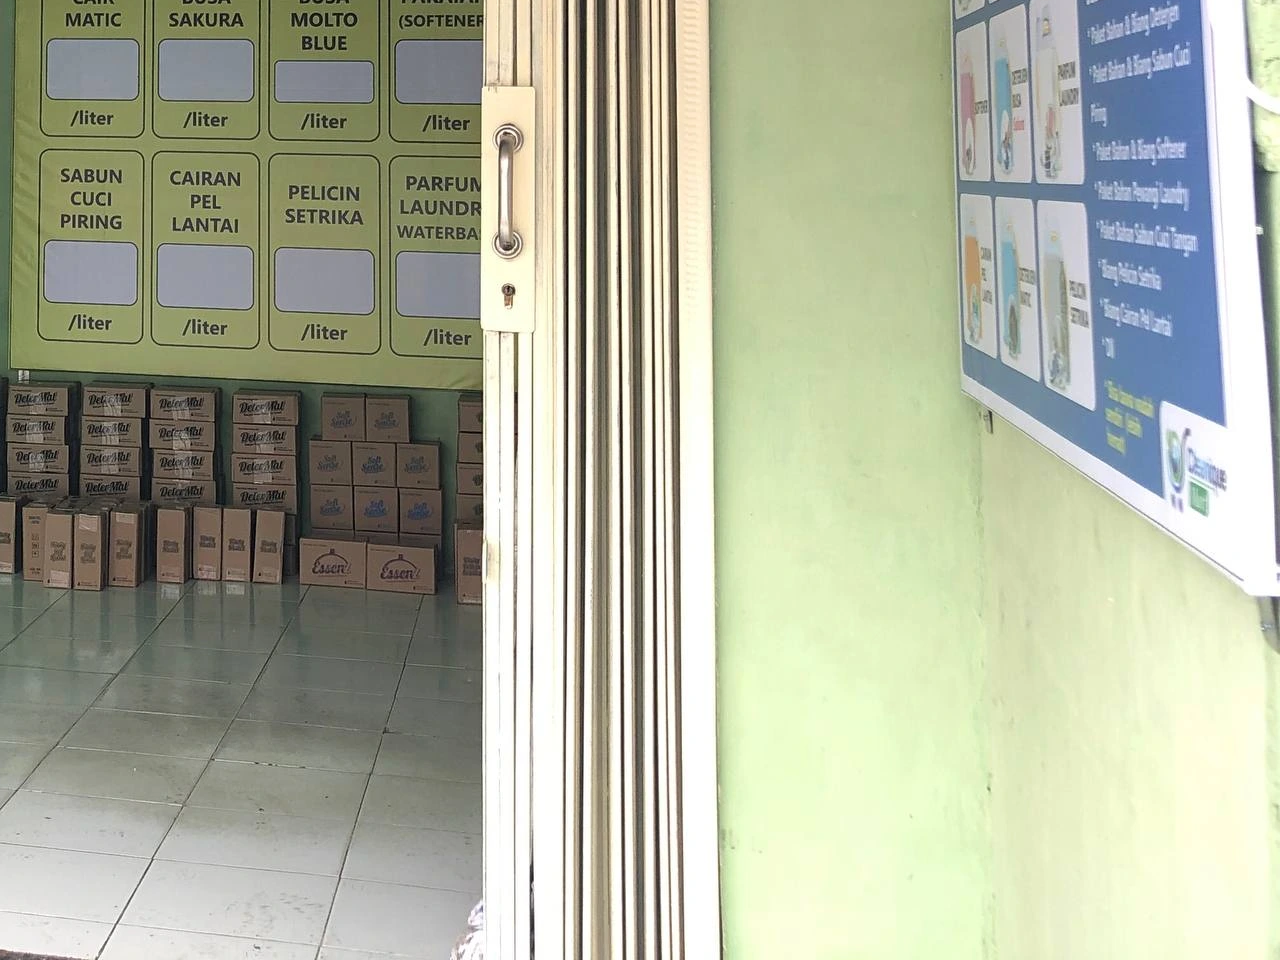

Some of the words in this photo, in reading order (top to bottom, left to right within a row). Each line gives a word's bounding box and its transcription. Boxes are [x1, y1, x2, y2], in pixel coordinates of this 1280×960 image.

[64, 12, 122, 29] MATIC
[168, 12, 244, 29] SAKURA
[290, 11, 359, 29] MOLTO
[301, 34, 347, 52] BLUE
[70, 111, 114, 128] /liter
[183, 111, 228, 129] /liter
[300, 113, 347, 131] /liter
[422, 115, 470, 133] /liter
[60, 168, 123, 185] SABUN
[169, 170, 241, 188] CAIRAN
[70, 191, 112, 208] CUCI
[190, 193, 221, 210] PEL
[288, 184, 360, 202] PELICIN
[59, 213, 123, 231] PIRING
[172, 216, 239, 234] LANTAI
[285, 208, 364, 226] SETRIKA
[397, 224, 481, 241] WATERBA
[68, 314, 112, 332] /liter
[182, 318, 228, 337] /liter
[300, 323, 348, 342] /liter
[423, 328, 472, 348] /liter
